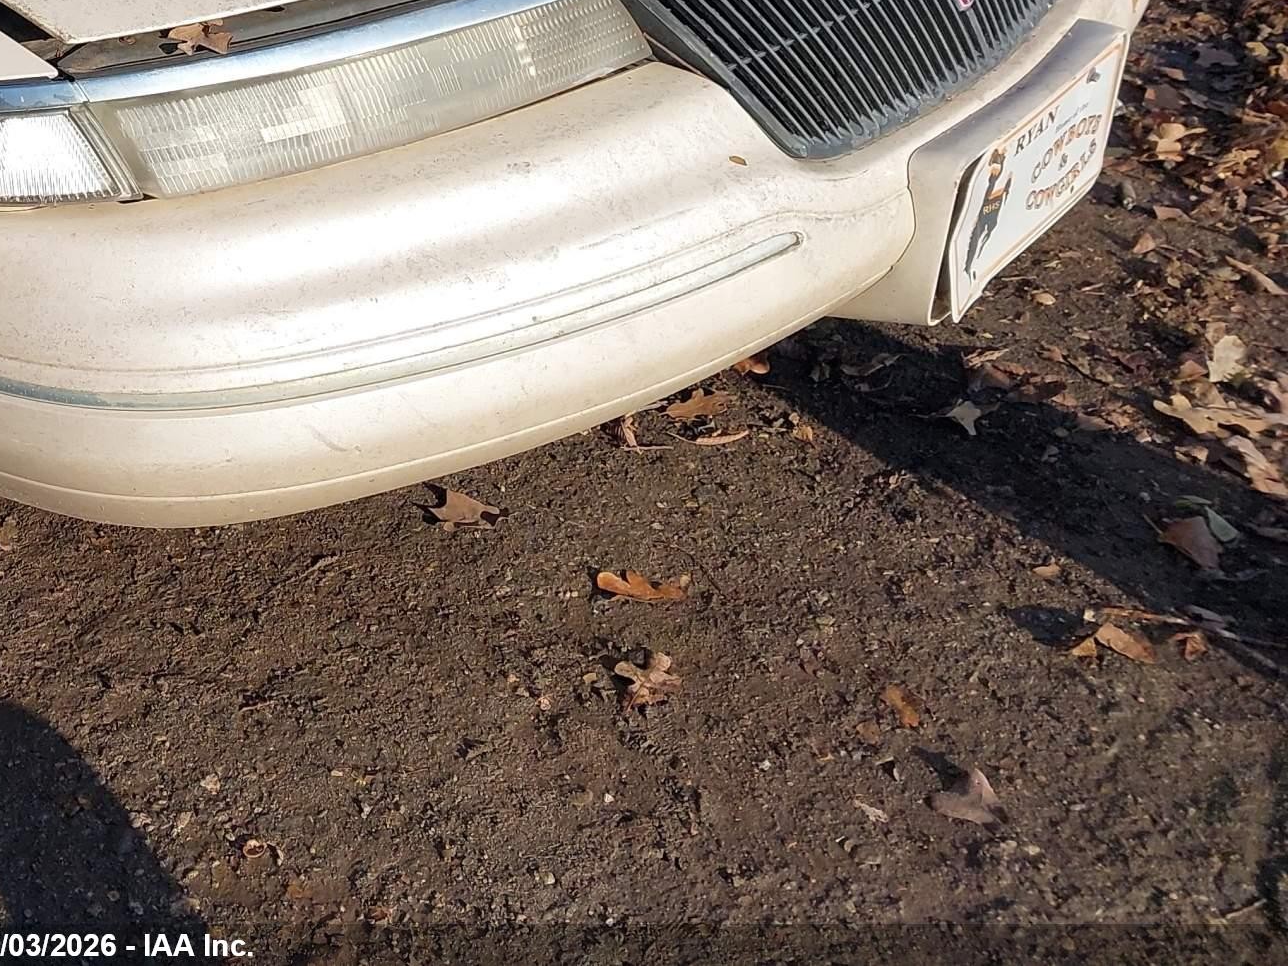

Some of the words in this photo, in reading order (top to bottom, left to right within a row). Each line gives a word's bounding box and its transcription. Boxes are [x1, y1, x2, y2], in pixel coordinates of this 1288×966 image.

[1014, 105, 1060, 156] RYAN
[1031, 114, 1102, 183] COWBOYS
[1026, 138, 1097, 210] COWGIRLS
[983, 201, 1001, 215] RHS
